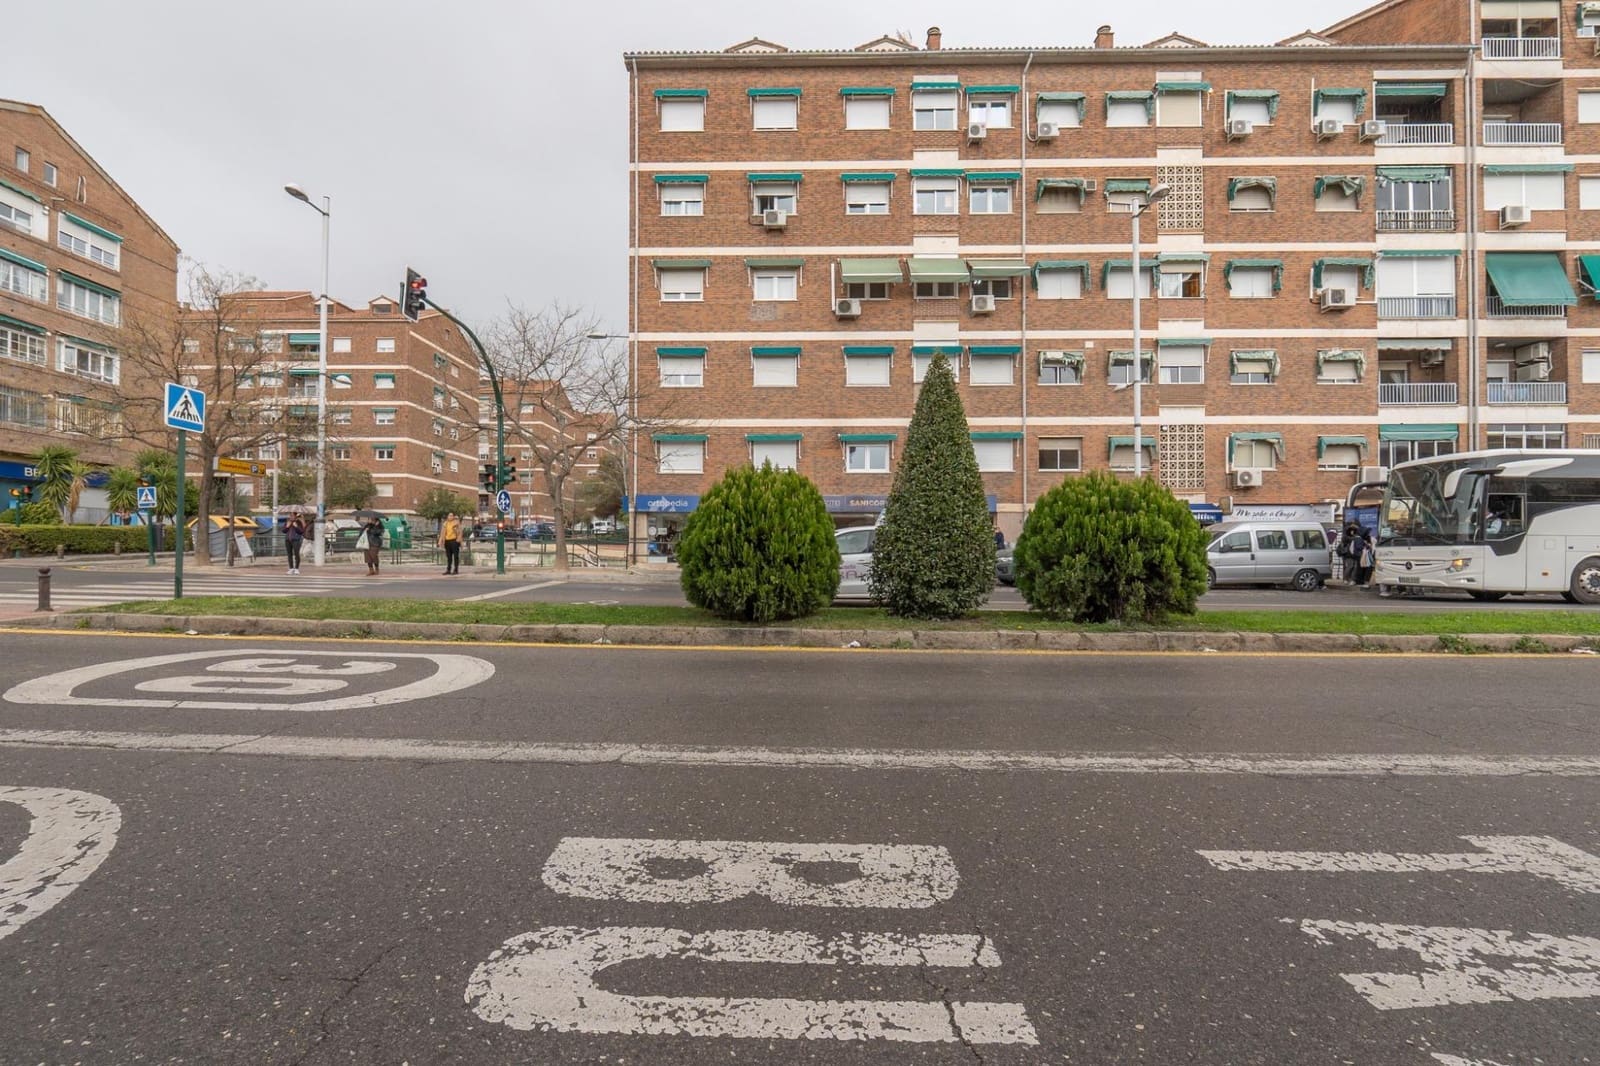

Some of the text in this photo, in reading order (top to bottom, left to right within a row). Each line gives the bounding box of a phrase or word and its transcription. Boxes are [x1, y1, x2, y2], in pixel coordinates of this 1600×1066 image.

[647, 498, 688, 508] ortopedia
[134, 658, 397, 695] 30
[464, 837, 1040, 1045] BU
